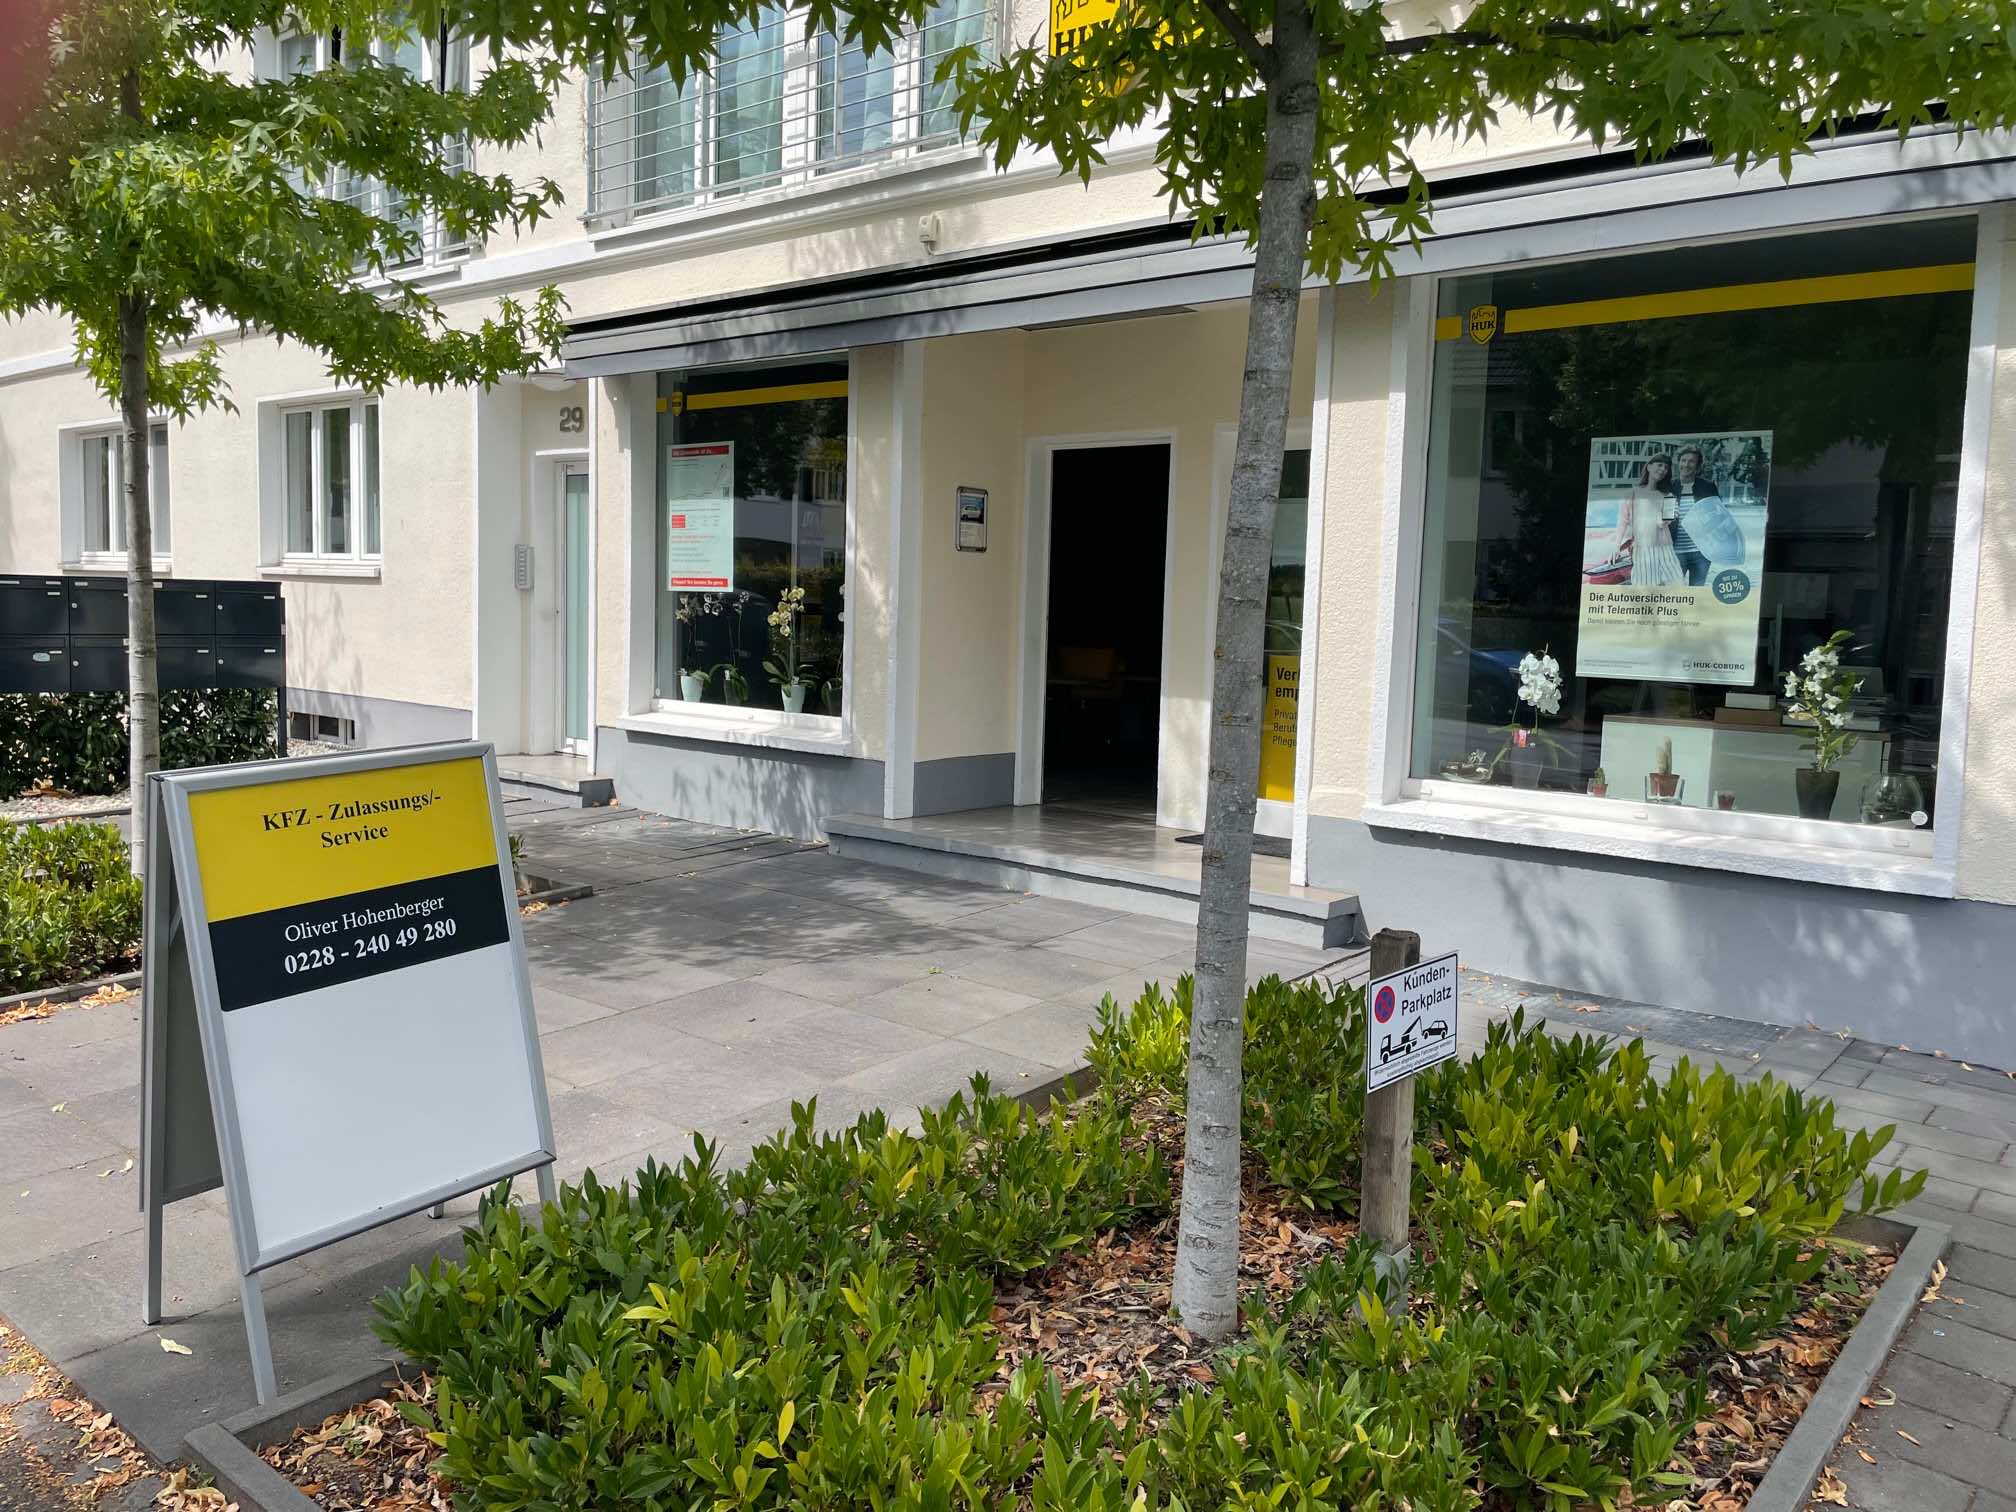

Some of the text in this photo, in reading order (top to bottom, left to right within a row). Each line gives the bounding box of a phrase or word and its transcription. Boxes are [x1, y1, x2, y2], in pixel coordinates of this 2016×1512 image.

[1472, 320, 1495, 331] HUK
[560, 406, 584, 432] 29
[1588, 605, 1679, 616] mit Telematik Plus
[1589, 592, 1695, 605] Die Autoversicherung
[1276, 667, 1300, 681] Ver
[263, 808, 311, 832] KFZ
[328, 789, 441, 821] Zulassungs/-
[320, 825, 389, 848] Service
[284, 897, 445, 942] Oliver Hohenberger
[284, 946, 335, 974] 0228
[354, 933, 390, 958] 240
[395, 926, 418, 948] 49
[423, 918, 457, 942] 280
[1401, 986, 1452, 1016] Parkplatz
